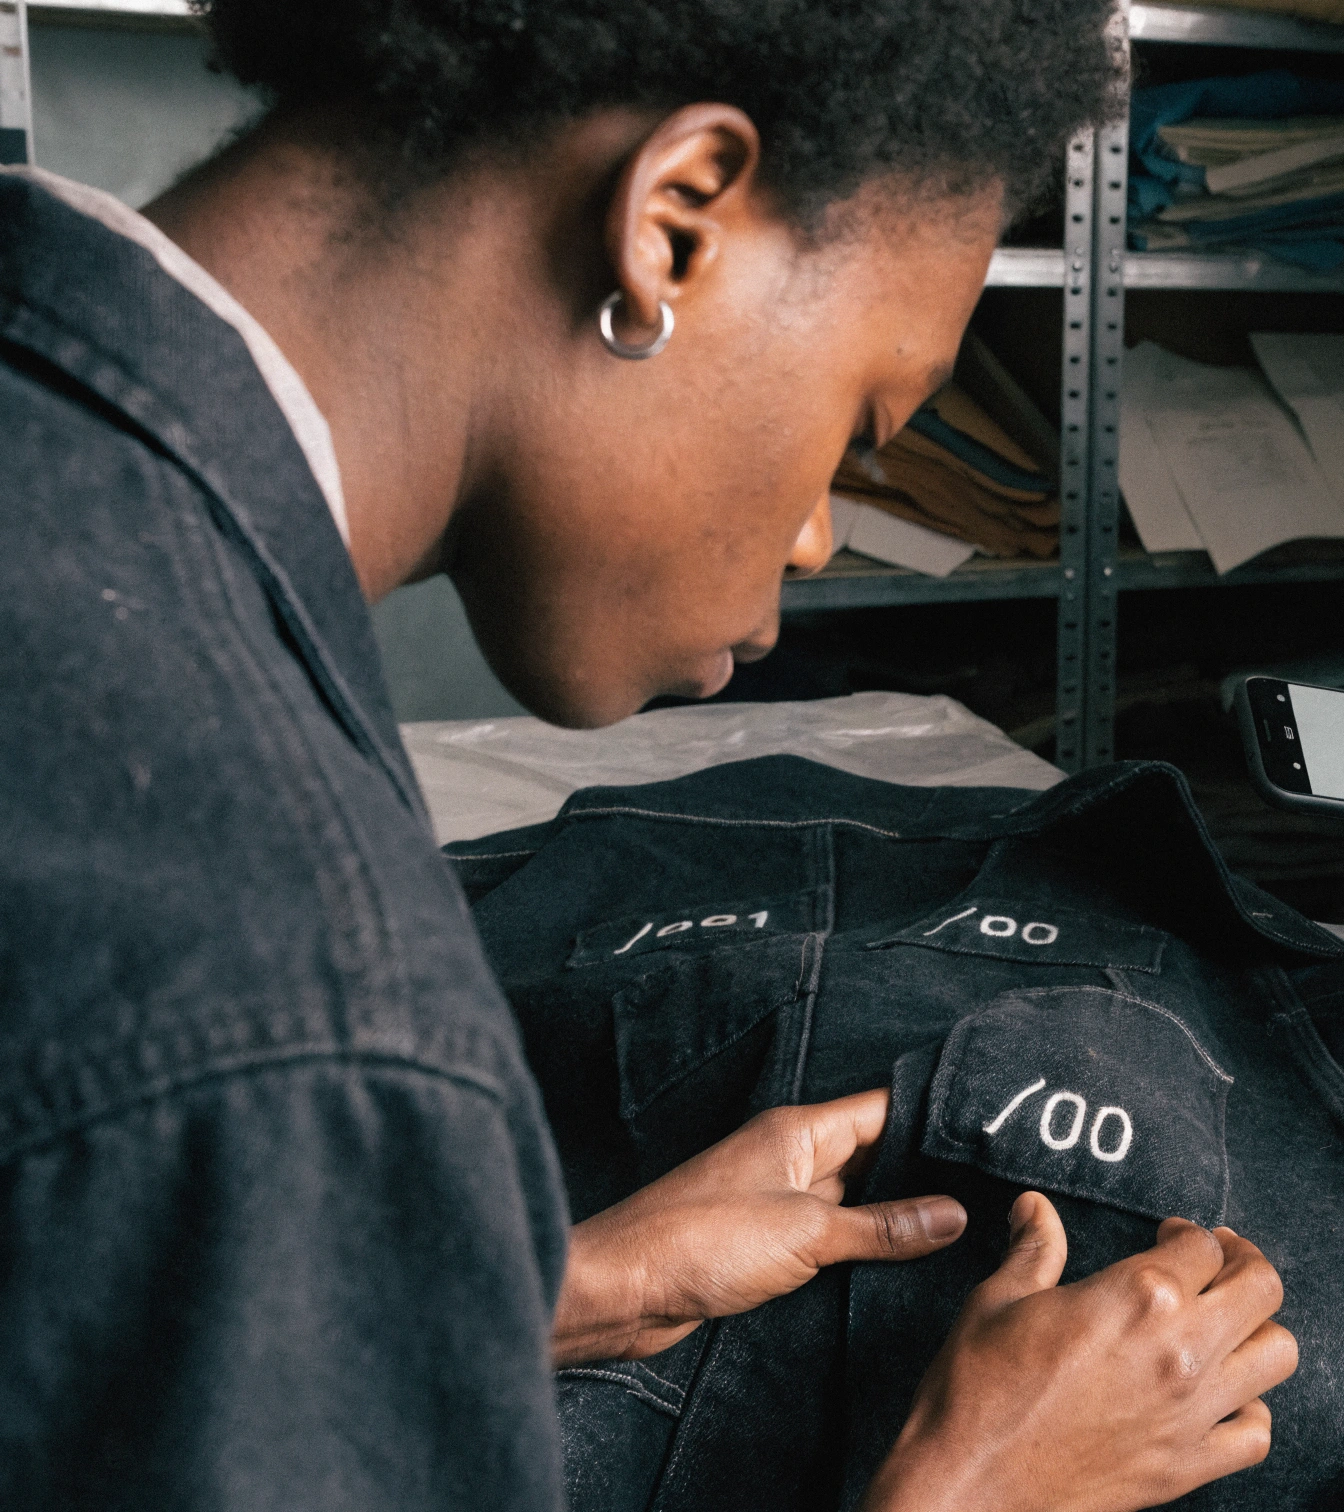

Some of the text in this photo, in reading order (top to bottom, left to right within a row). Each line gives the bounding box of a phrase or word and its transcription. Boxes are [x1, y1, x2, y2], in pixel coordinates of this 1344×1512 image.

[613, 910, 769, 955] /001
[923, 906, 1059, 945] /00
[982, 1077, 1134, 1163] /00
